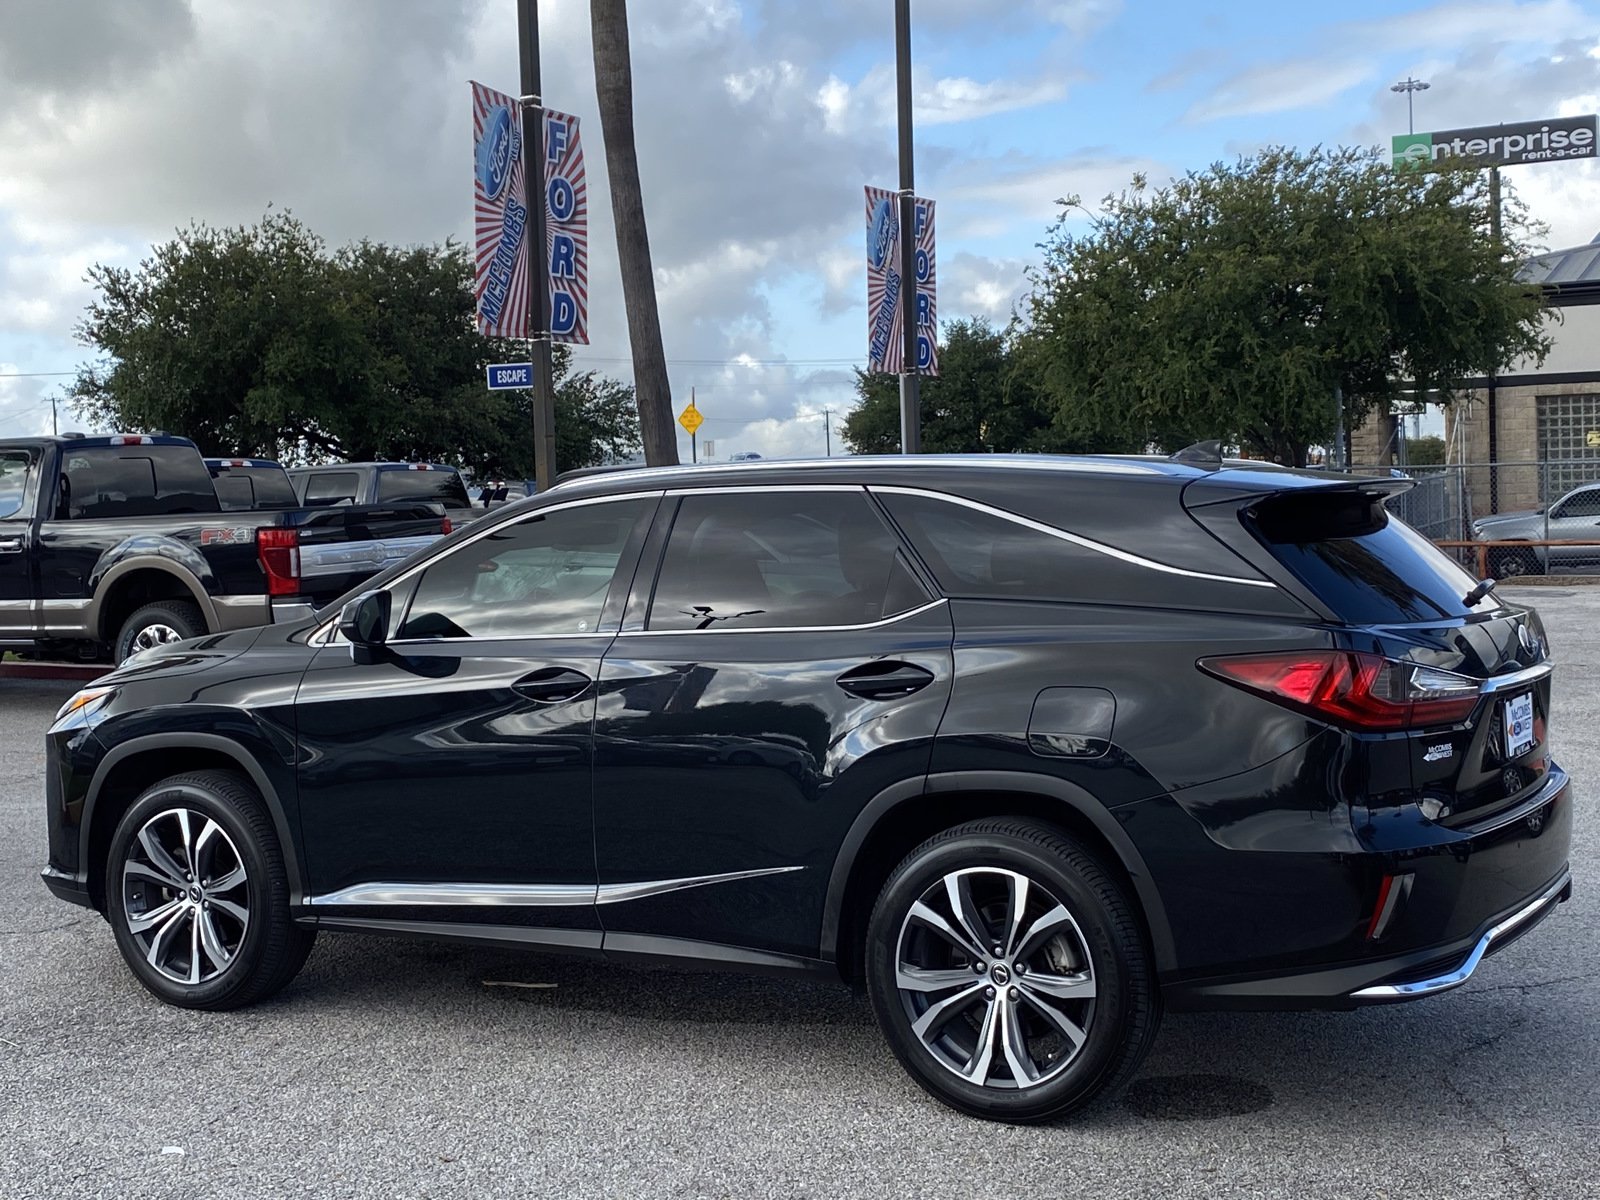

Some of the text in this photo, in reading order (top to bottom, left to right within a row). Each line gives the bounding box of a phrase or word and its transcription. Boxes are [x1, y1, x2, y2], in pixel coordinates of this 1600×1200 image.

[488, 122, 509, 184] Ford
[1394, 126, 1594, 161] enterprise
[1522, 145, 1592, 160] rent-a-car
[547, 119, 576, 334] FORD
[914, 204, 930, 369] FORD
[496, 369, 527, 384] ESCAPE
[200, 527, 251, 545] FX4
